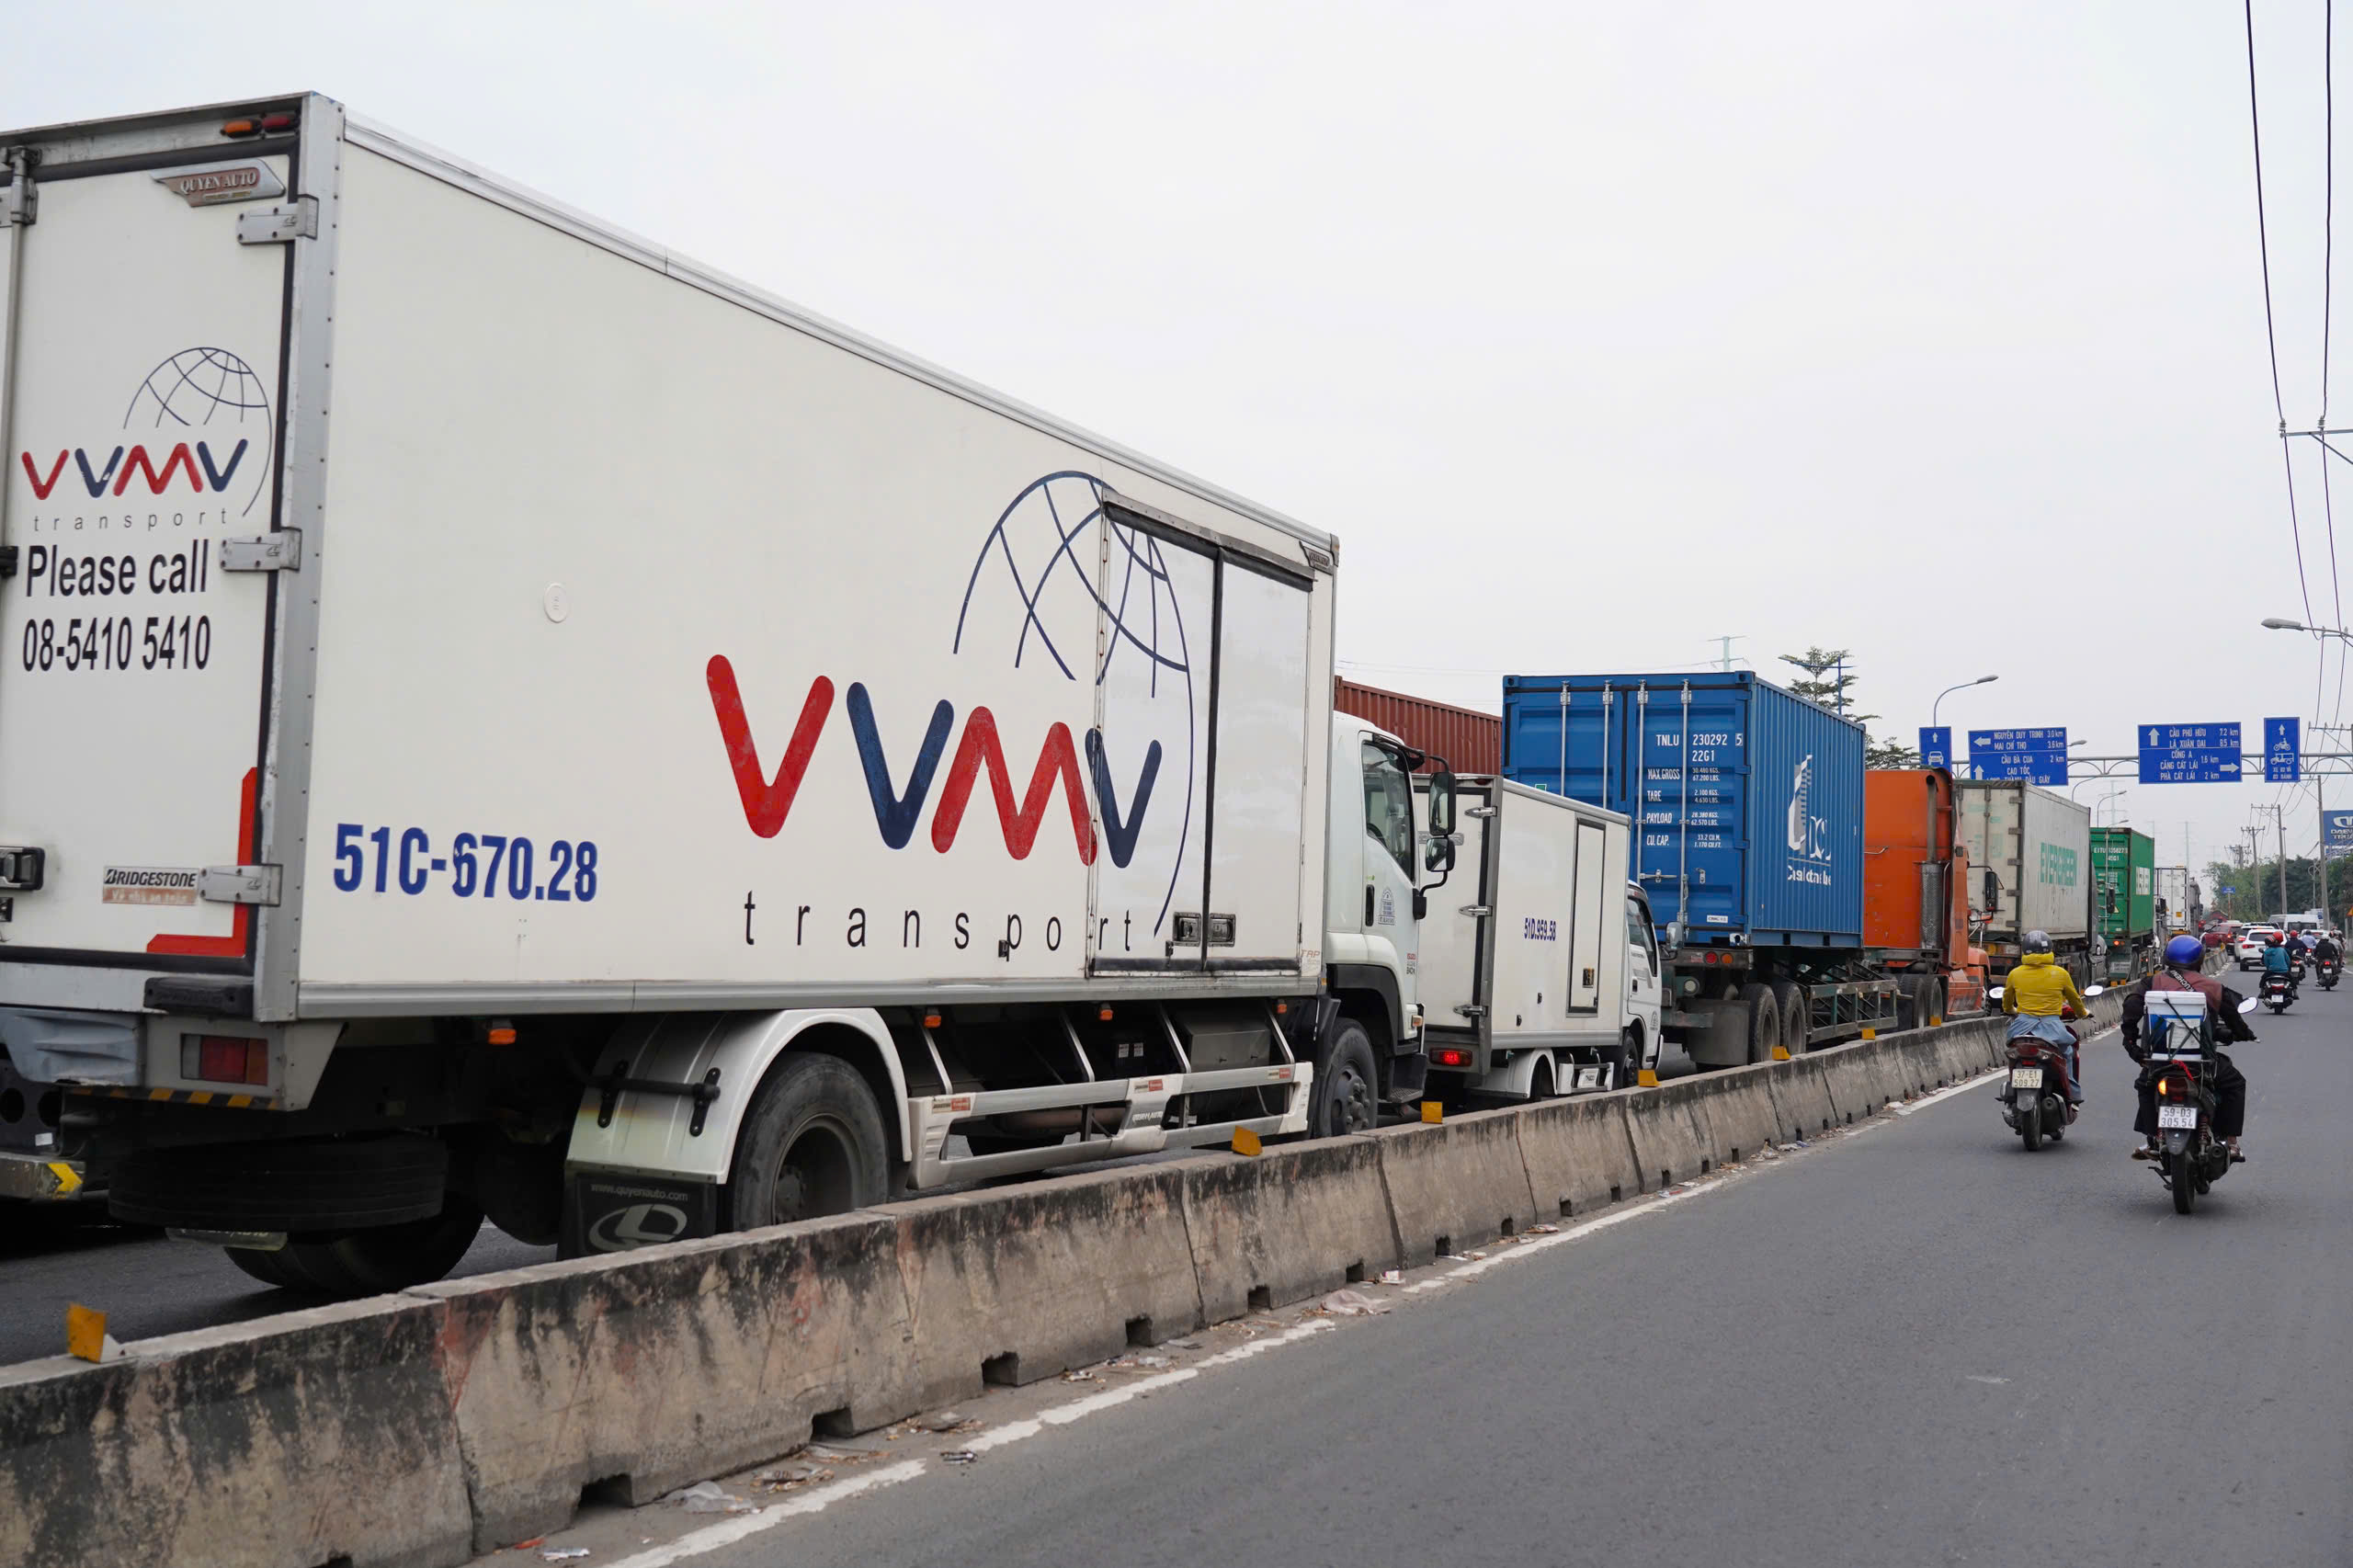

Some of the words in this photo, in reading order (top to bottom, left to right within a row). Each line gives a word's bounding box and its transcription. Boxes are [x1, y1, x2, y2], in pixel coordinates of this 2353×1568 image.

[224, 171, 256, 187] AUTO
[34, 507, 227, 531] transport
[26, 544, 136, 597] Please
[149, 539, 209, 594] call
[23, 617, 132, 672] 08-5410
[142, 615, 210, 670] 5410
[1656, 734, 1679, 746] TNLU
[1692, 734, 1728, 745] 230292
[1735, 733, 1743, 746] 5
[2016, 731, 2026, 739] DUY
[1994, 742, 2004, 750] MAI
[2006, 739, 2014, 750] CHÍ
[1692, 750, 1715, 762] 22G1
[2177, 759, 2187, 769] CÁT
[2189, 759, 2199, 769] LÁI
[2160, 771, 2171, 780] PHÀ
[2174, 771, 2183, 779] CÁT
[2187, 771, 2195, 779] LÁI
[1647, 790, 1662, 801] TARE
[1646, 812, 1672, 824] PAYLOAD
[1647, 835, 1655, 846] CU.
[1657, 835, 1669, 846] CAP.
[334, 824, 597, 903] 51C-670.28
[744, 890, 1131, 962] transport
[2162, 1118, 2193, 1128] 305.54
